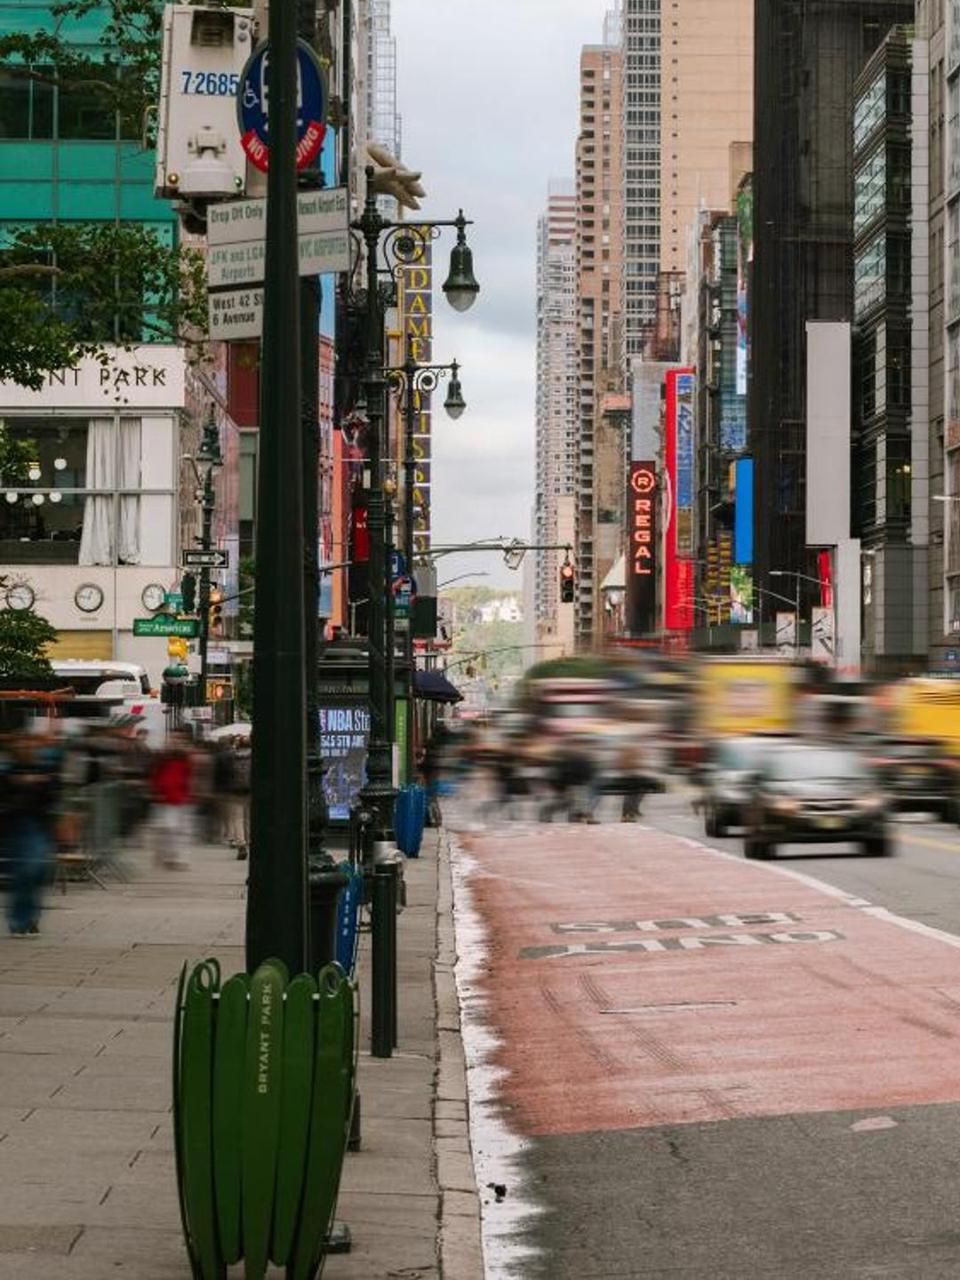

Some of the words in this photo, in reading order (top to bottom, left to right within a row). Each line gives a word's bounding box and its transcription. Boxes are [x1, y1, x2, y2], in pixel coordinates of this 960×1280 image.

[247, 136, 263, 160] NO
[210, 208, 229, 223] Drop
[231, 207, 243, 221] Off
[245, 206, 263, 220] Only
[211, 248, 228, 264] JFK
[230, 249, 244, 262] and
[221, 266, 255, 281] Airports
[213, 297, 235, 311] West
[239, 294, 250, 307] 42
[212, 314, 219, 326] 6
[222, 311, 255, 325] Avenue
[100, 368, 166, 386] PARK
[635, 499, 651, 574] REGAL
[328, 709, 353, 731] NBA
[545, 931, 842, 958] ONLY
[261, 983, 272, 1024] PARK
[258, 1032, 269, 1093] BRYANT
